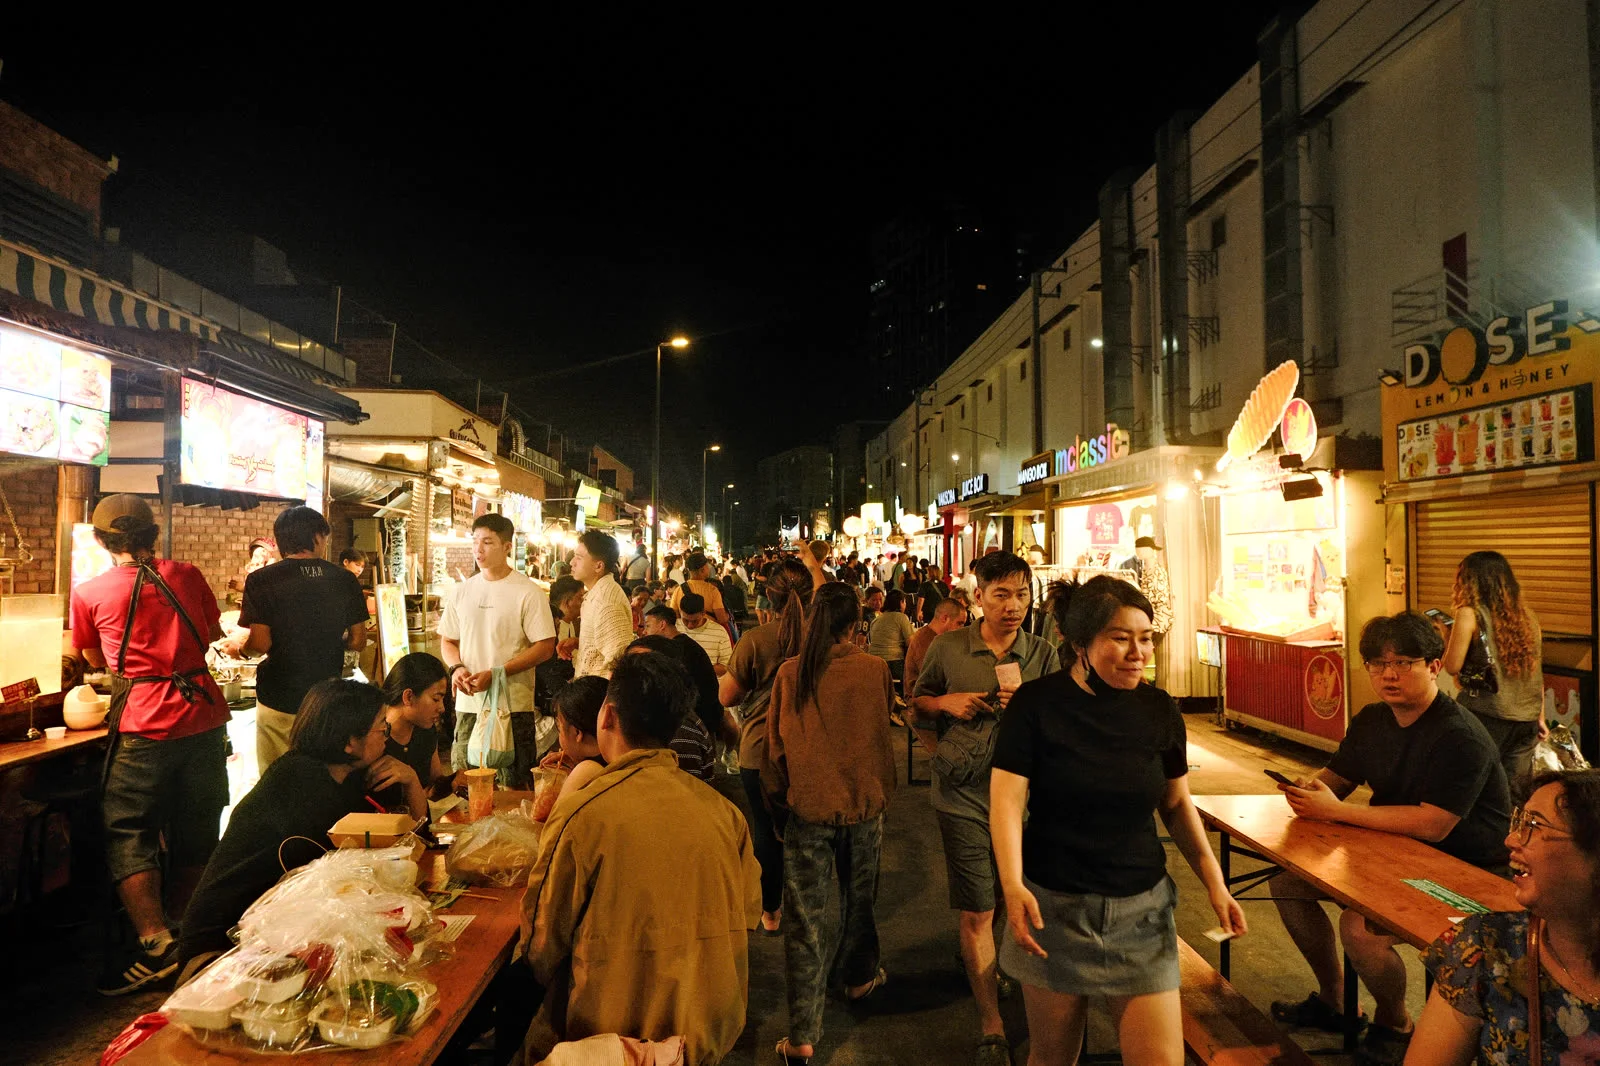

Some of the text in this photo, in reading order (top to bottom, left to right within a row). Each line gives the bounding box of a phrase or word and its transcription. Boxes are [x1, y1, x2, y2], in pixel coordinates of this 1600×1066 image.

[1482, 385, 1490, 394] &
[1054, 423, 1124, 476] mclassic
[961, 473, 984, 501] JUICE BOX
[1017, 465, 1037, 485] MANGO
